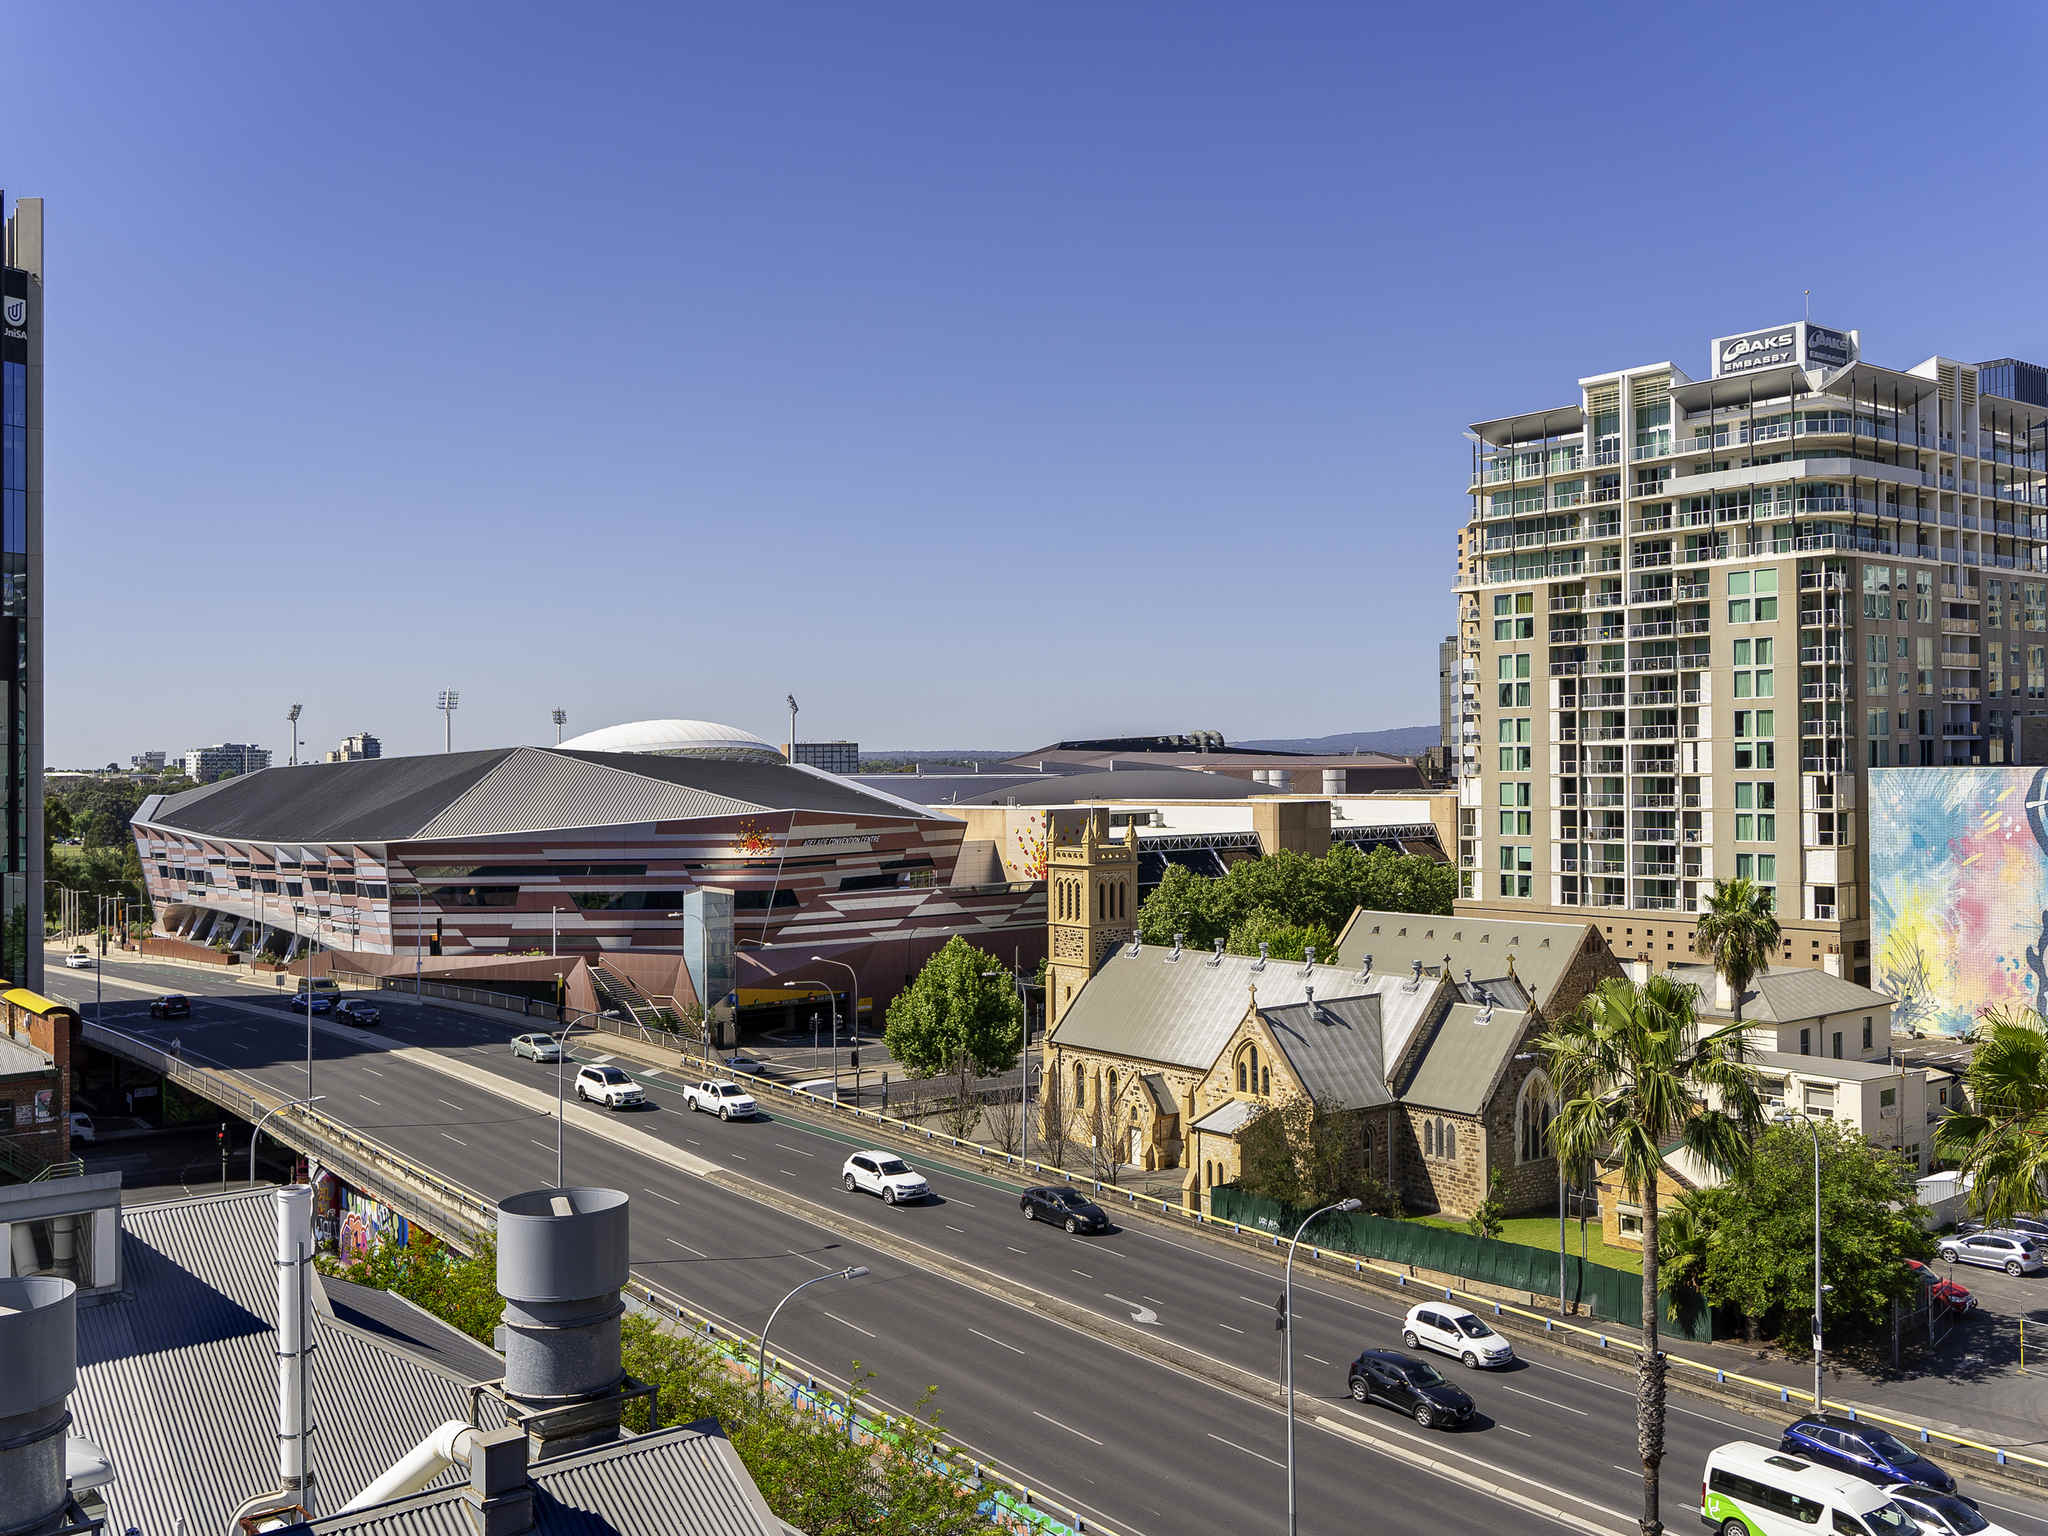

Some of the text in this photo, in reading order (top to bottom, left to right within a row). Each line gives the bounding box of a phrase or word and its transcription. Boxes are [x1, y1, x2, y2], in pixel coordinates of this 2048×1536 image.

[1722, 334, 1793, 362] OAKS
[1808, 330, 1848, 351] OAKS
[1724, 351, 1790, 371] EMBASSY
